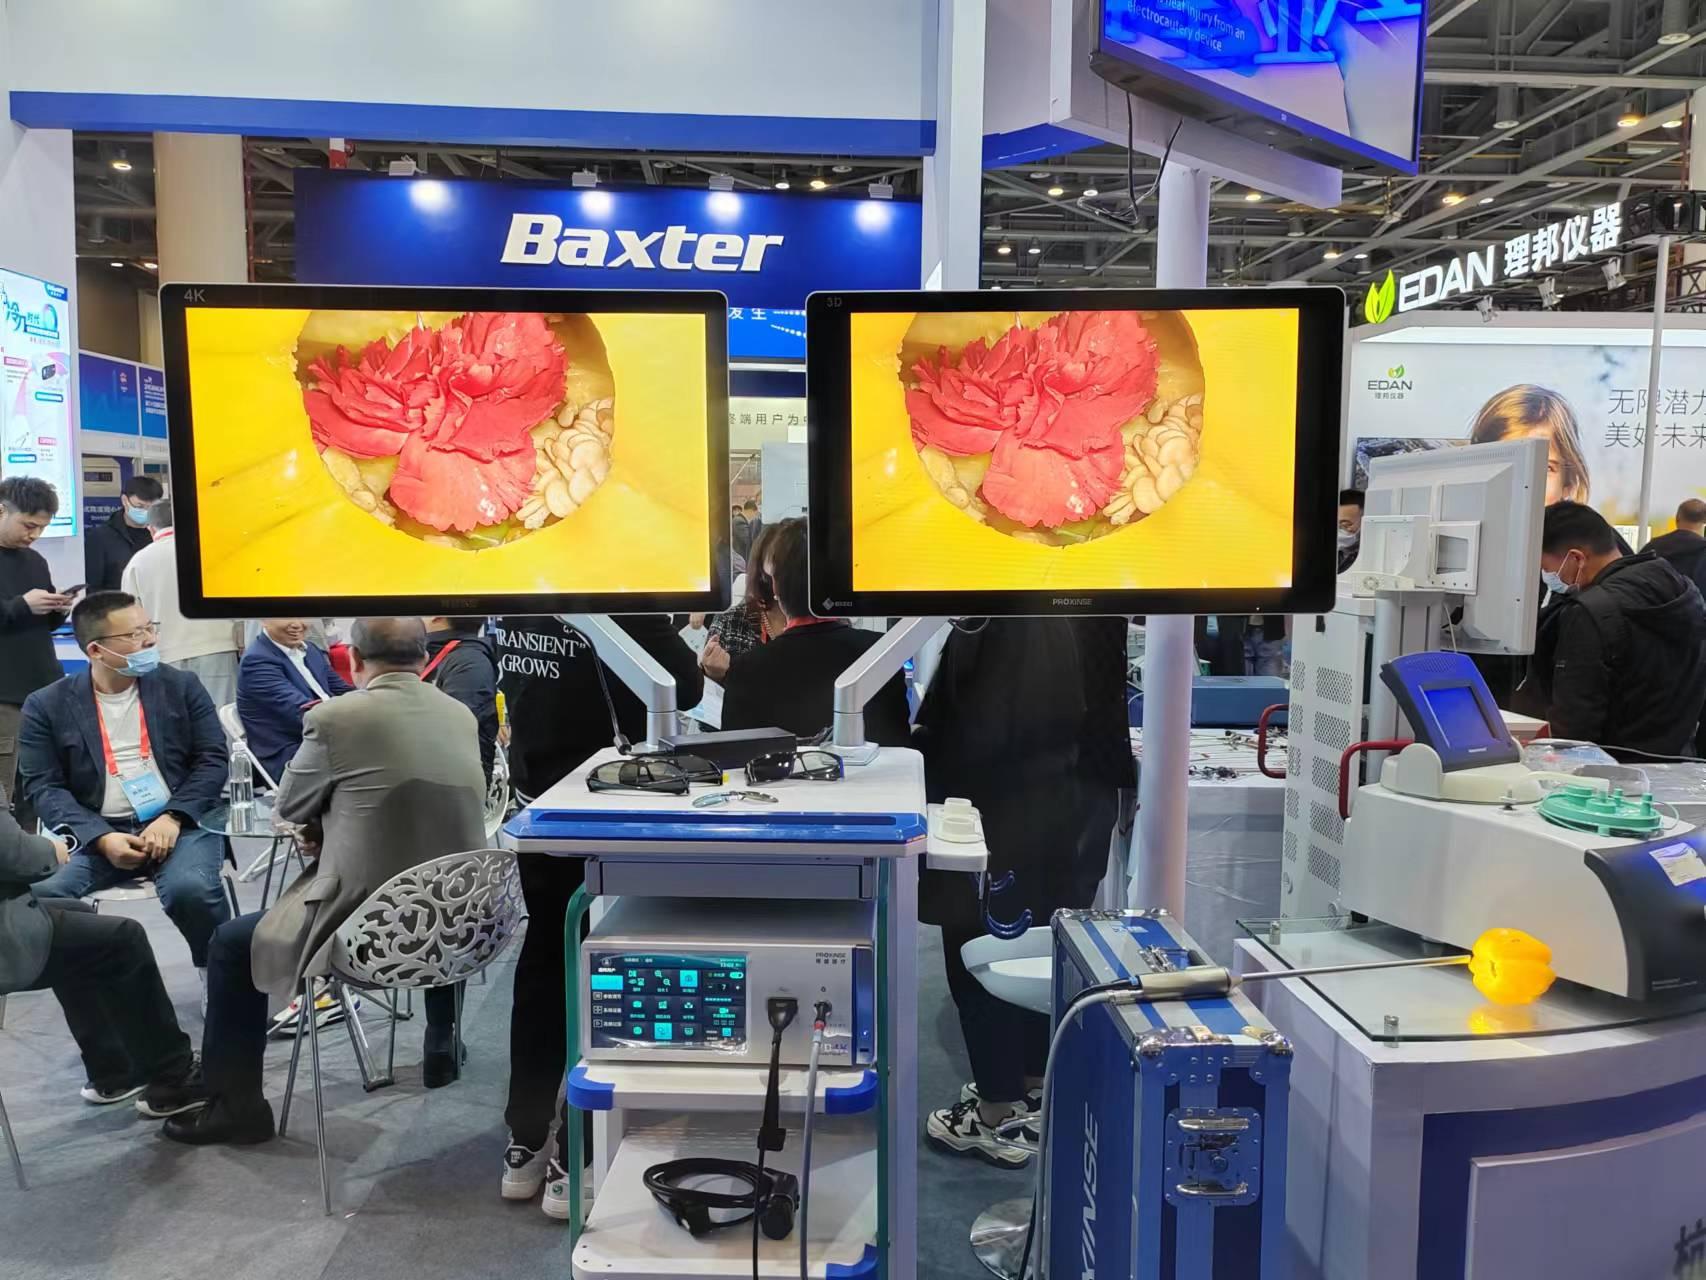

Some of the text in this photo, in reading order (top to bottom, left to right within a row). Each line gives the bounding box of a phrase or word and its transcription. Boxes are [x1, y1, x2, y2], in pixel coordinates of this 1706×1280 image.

[1127, 0, 1222, 51] electrocautery device
[1187, 6, 1213, 29] injury
[1214, 15, 1234, 37] from
[1234, 28, 1246, 40] an
[500, 212, 784, 272] Baxter
[1398, 201, 1623, 313] EDAN 理邦仪器
[184, 289, 206, 303] 4K
[1367, 380, 1413, 391] EDAN
[1052, 598, 1093, 606] PROXINSE
[502, 653, 560, 679] GROWS
